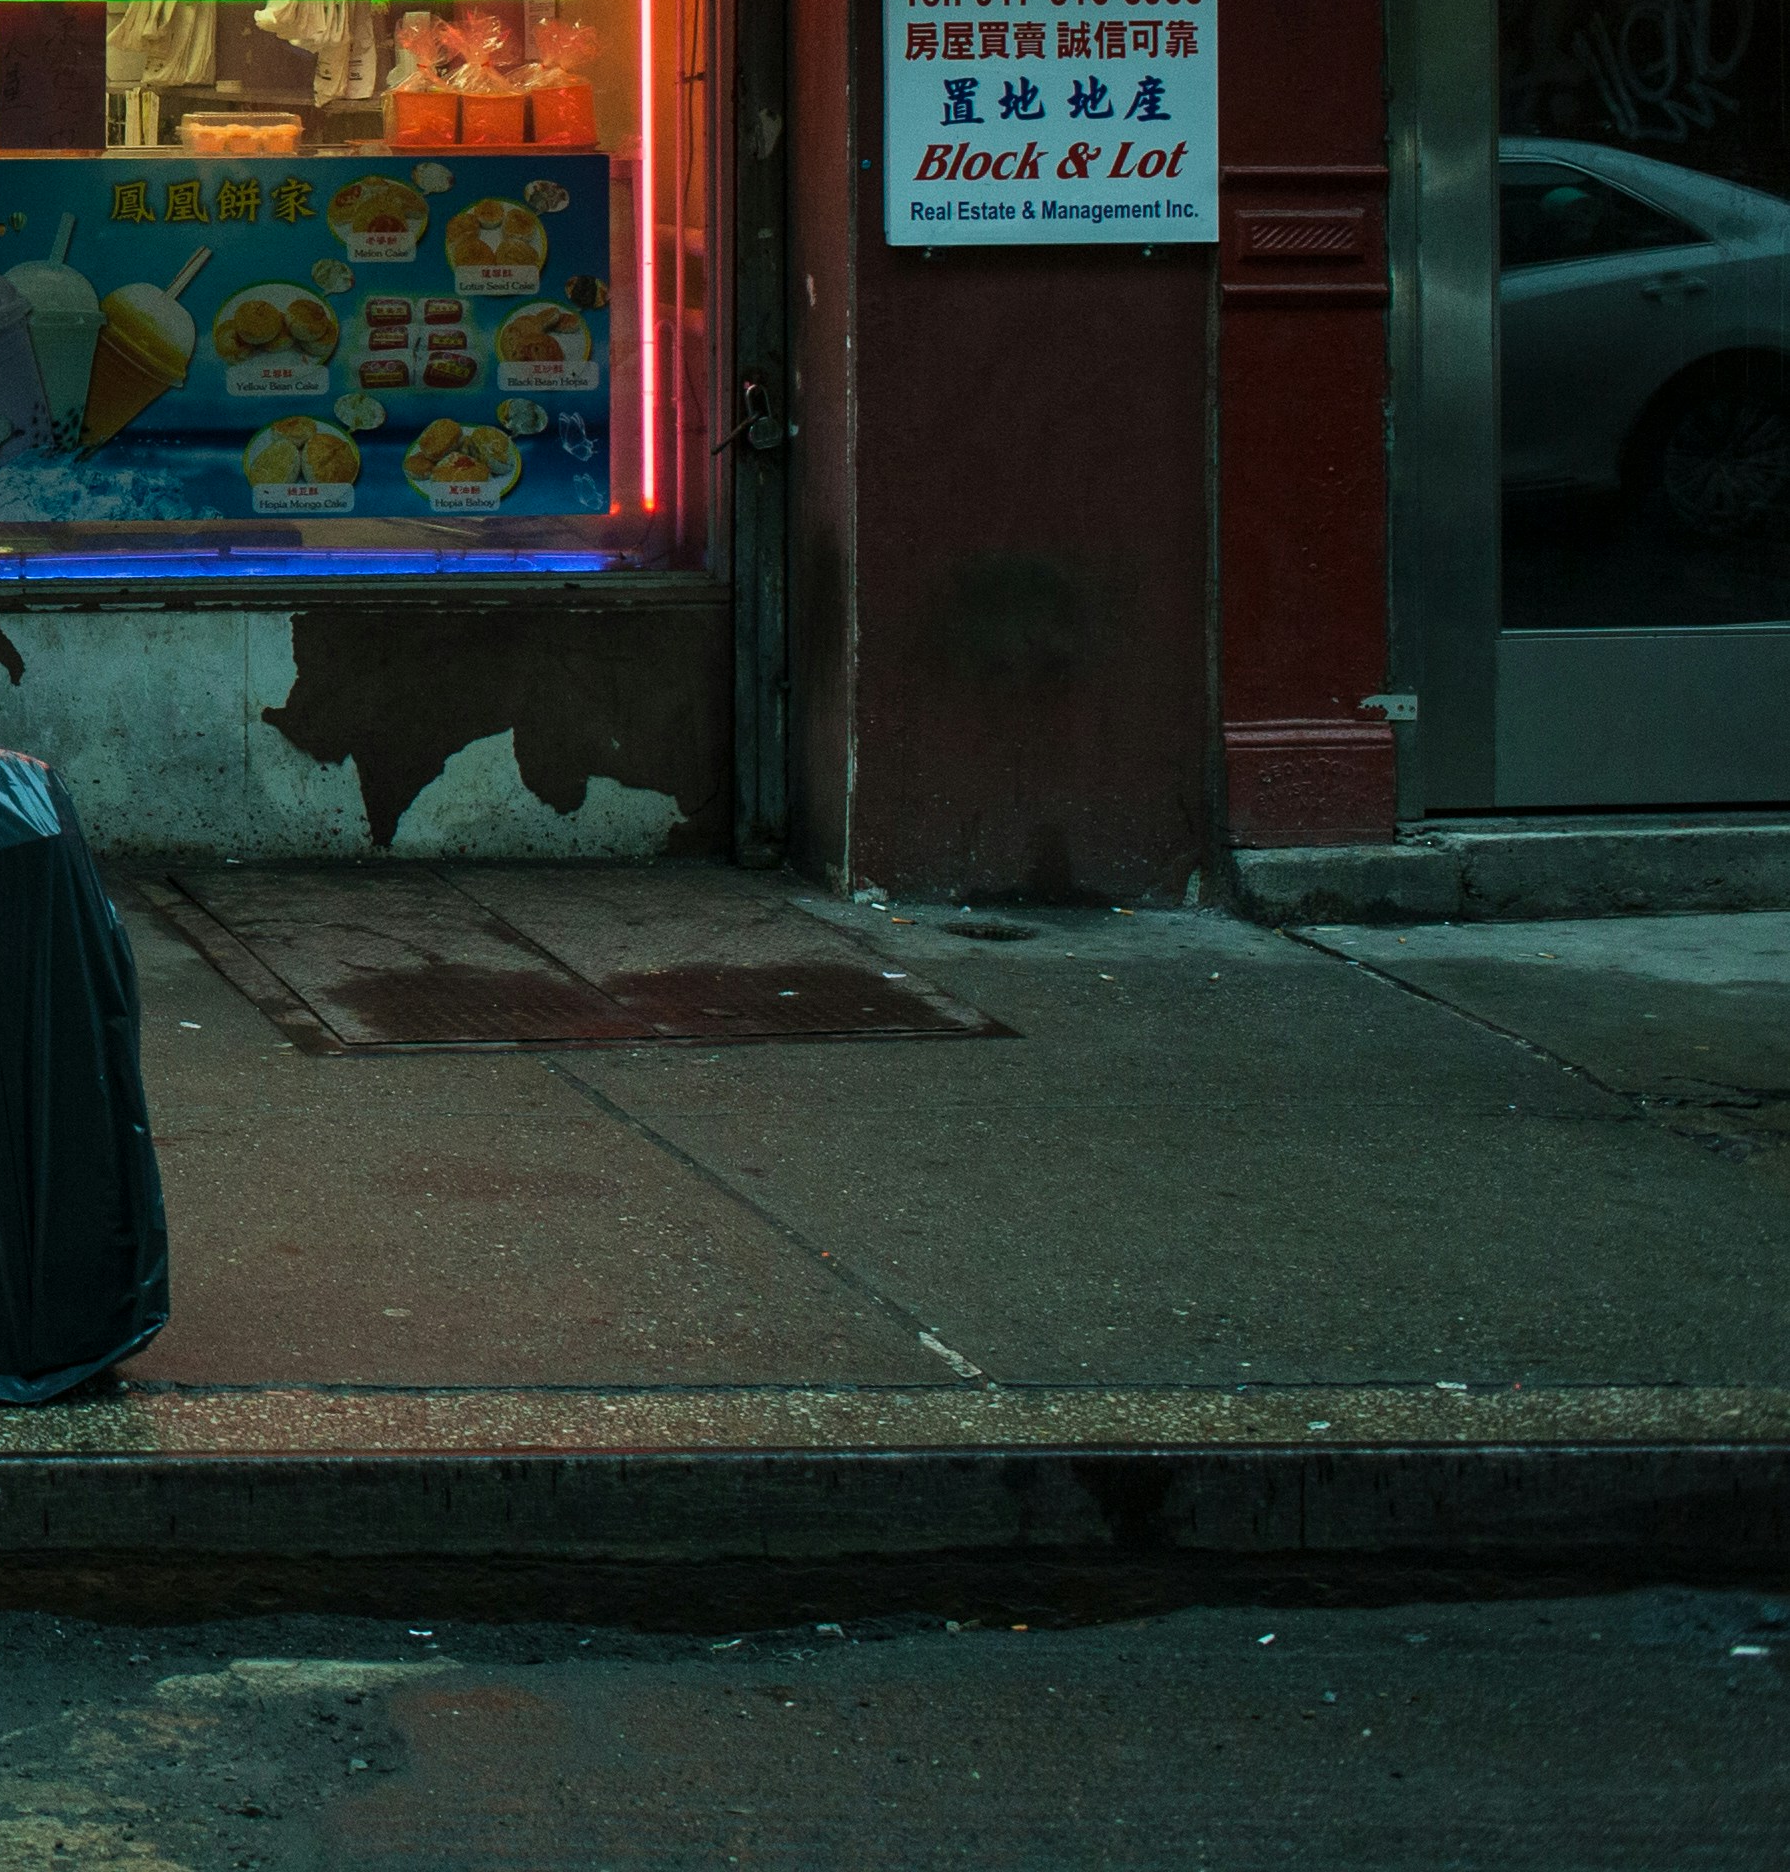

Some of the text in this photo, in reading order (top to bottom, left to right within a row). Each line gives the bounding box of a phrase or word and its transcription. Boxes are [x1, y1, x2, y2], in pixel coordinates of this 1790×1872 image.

[905, 20, 1198, 61] 房屋買賣 誠信可靠
[940, 75, 1171, 126] 置地地產
[913, 140, 1189, 180] Block & Lot
[111, 177, 318, 225] 鳳凰餅家
[911, 200, 1199, 223] Real Estate & Management Inc.
